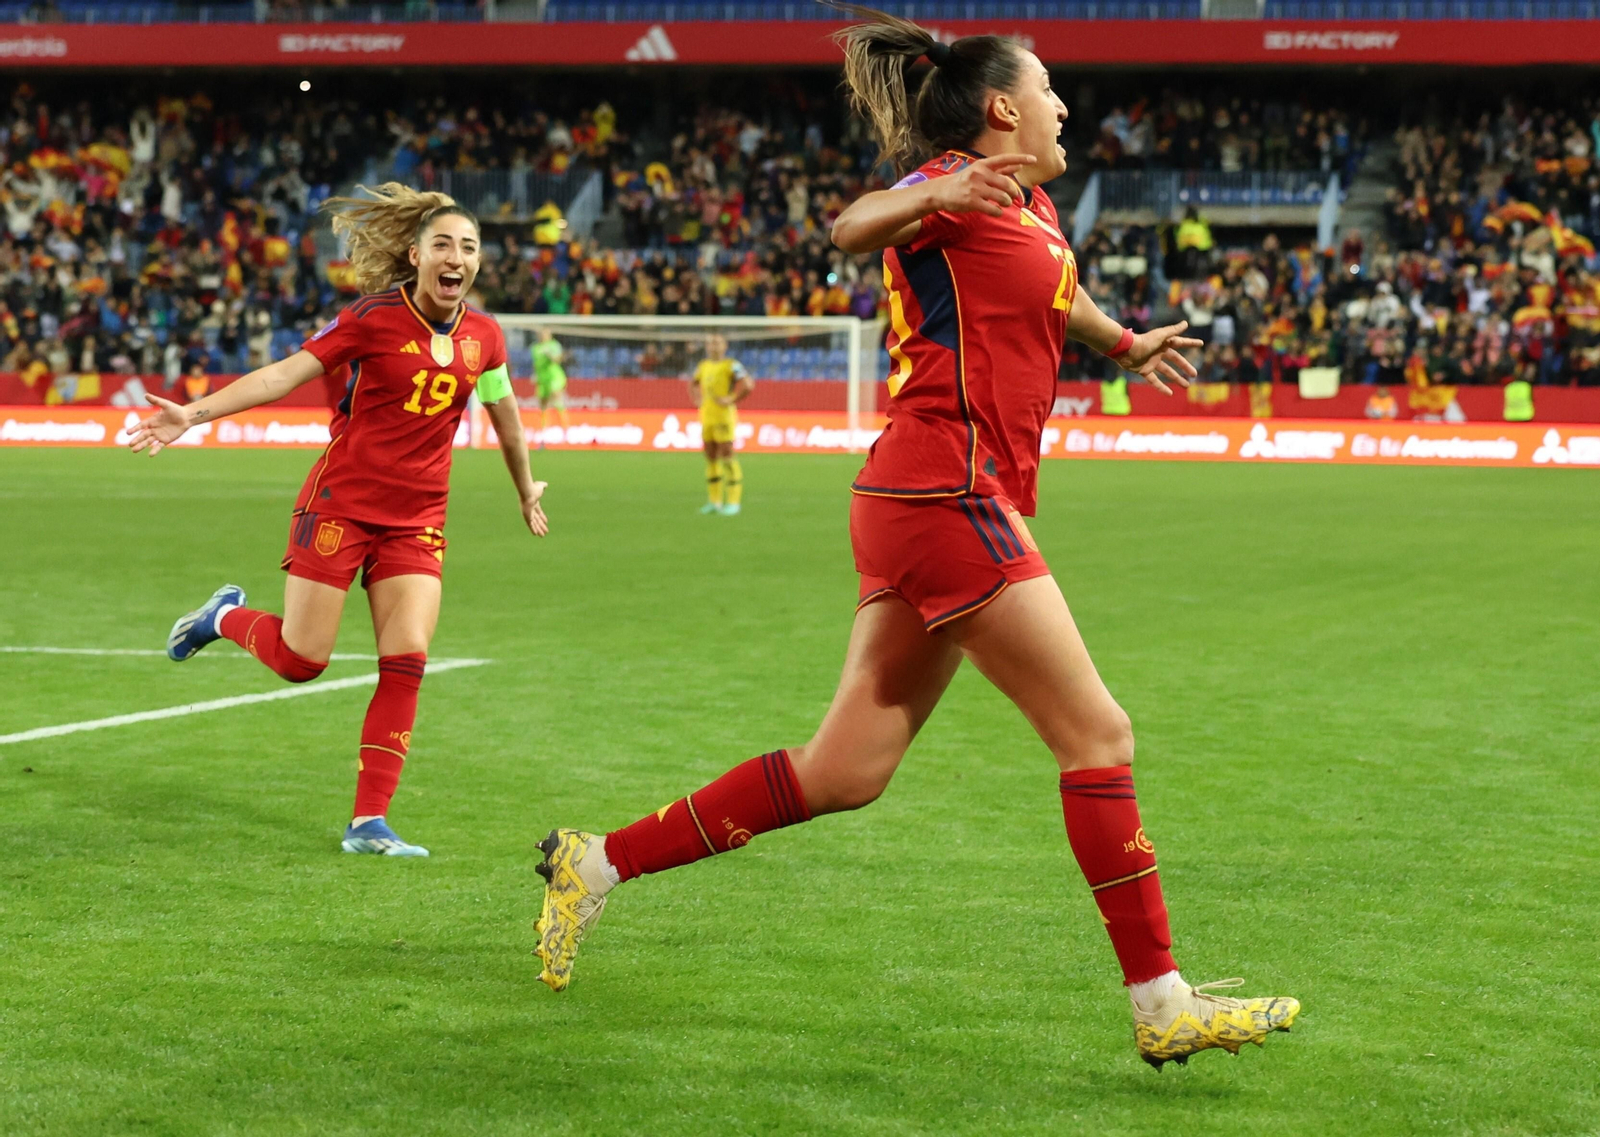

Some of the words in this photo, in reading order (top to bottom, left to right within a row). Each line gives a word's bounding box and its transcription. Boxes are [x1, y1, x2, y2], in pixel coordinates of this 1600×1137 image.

[307, 34, 405, 52] FACTORY
[1294, 31, 1399, 50] FACTORY
[403, 369, 458, 416] 19
[1123, 840, 1136, 853] 19
